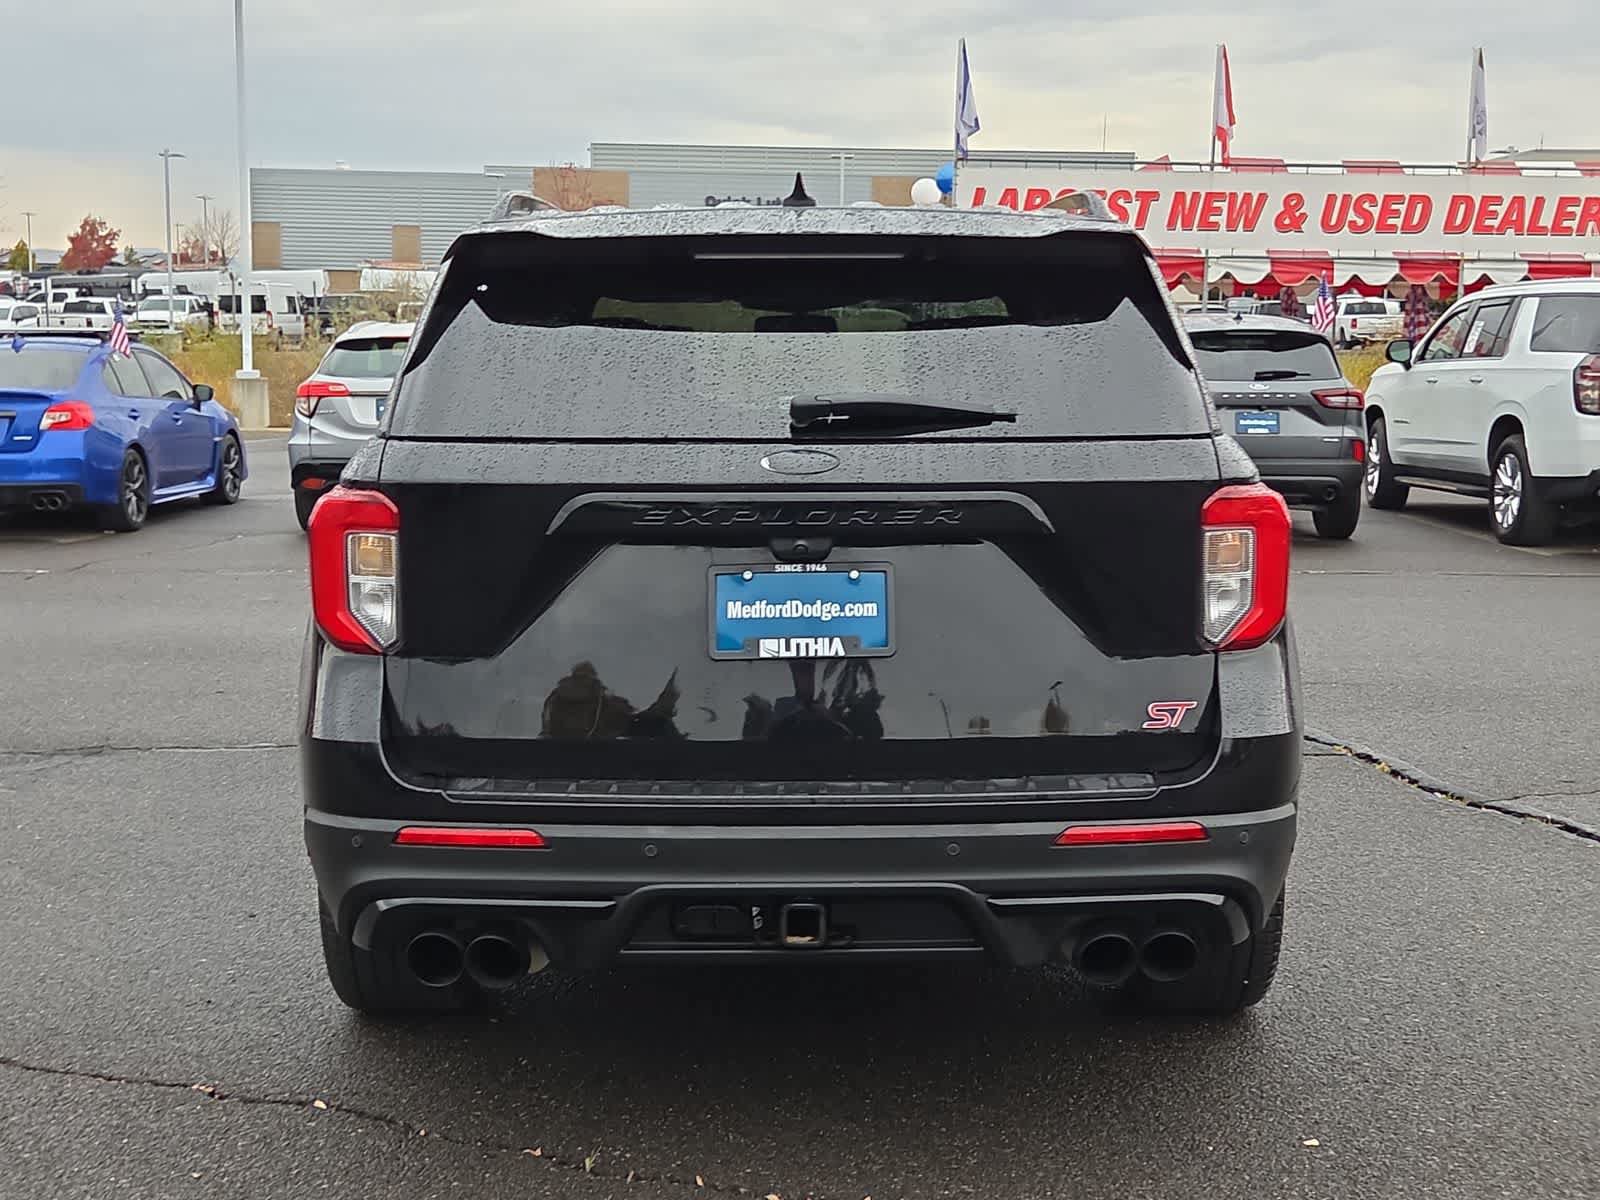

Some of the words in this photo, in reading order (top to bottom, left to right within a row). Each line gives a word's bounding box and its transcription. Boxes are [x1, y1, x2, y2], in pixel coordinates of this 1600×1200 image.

[971, 187, 1160, 230] ARST
[1166, 191, 1268, 232] NEW
[1274, 192, 1308, 233] &
[1320, 193, 1433, 234] USED
[632, 508, 963, 526] EXPLORER
[774, 563, 803, 572] SINCE
[727, 600, 878, 621] MedfordDodge.com
[780, 637, 846, 657] LITHIA
[1142, 701, 1198, 729] ST
